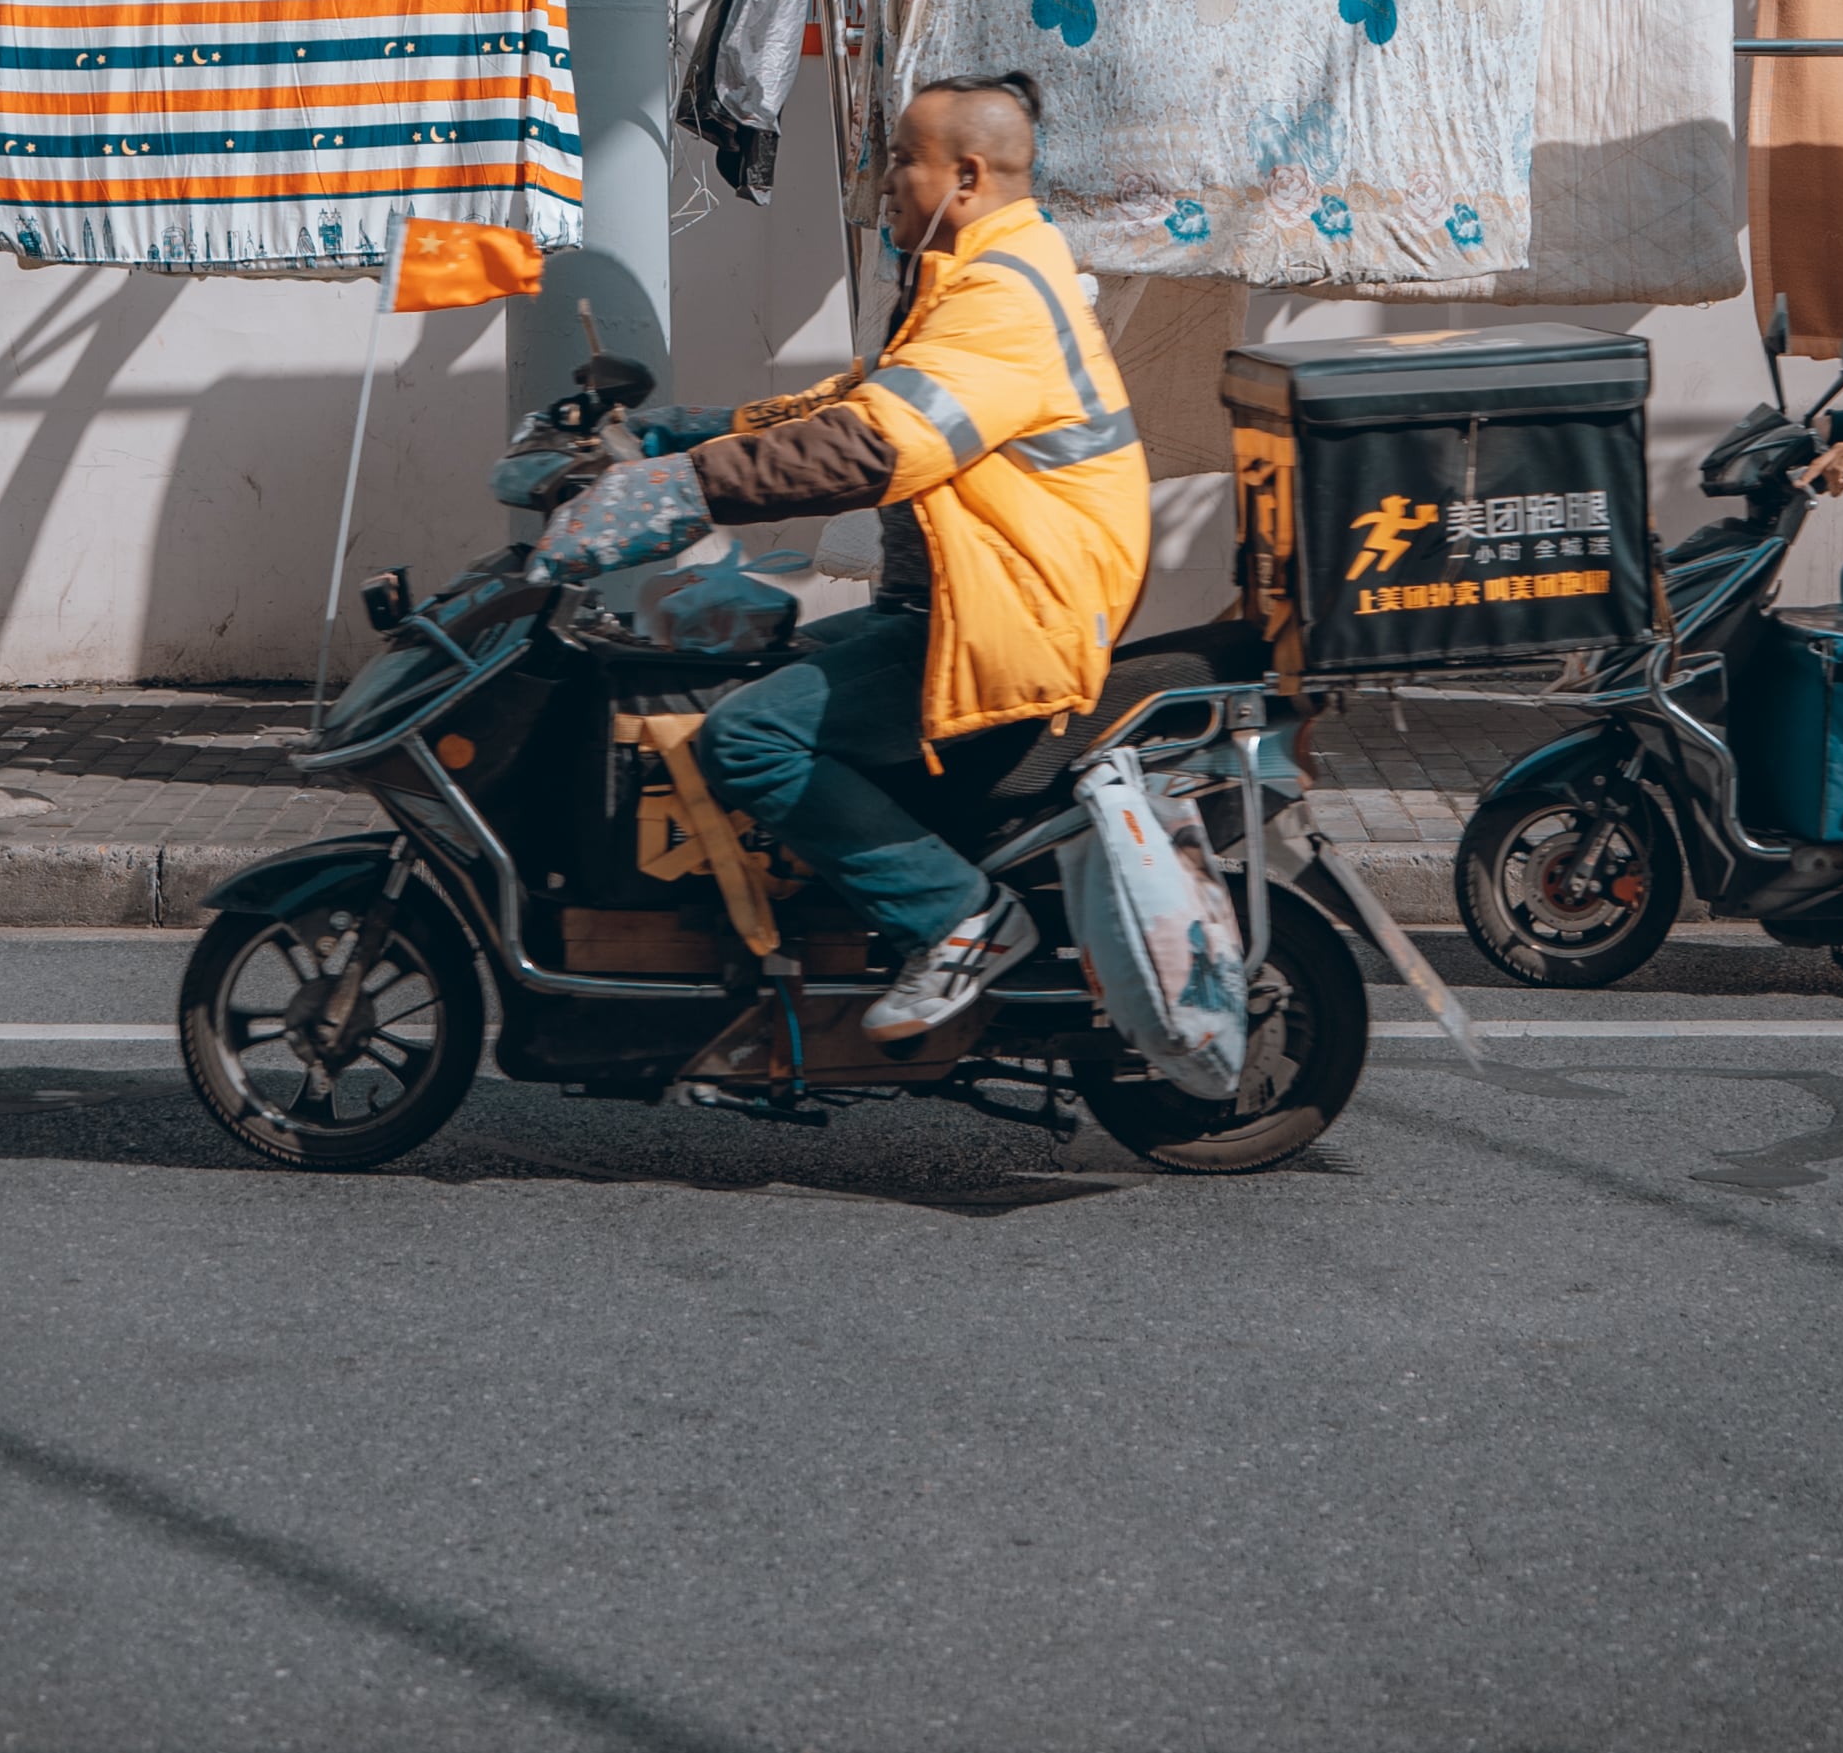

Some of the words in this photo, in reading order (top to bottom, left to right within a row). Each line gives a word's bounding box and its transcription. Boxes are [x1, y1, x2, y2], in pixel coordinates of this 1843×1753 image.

[1446, 490, 1612, 543] 美团跑腿
[1353, 580, 1481, 615] 上美团外卖
